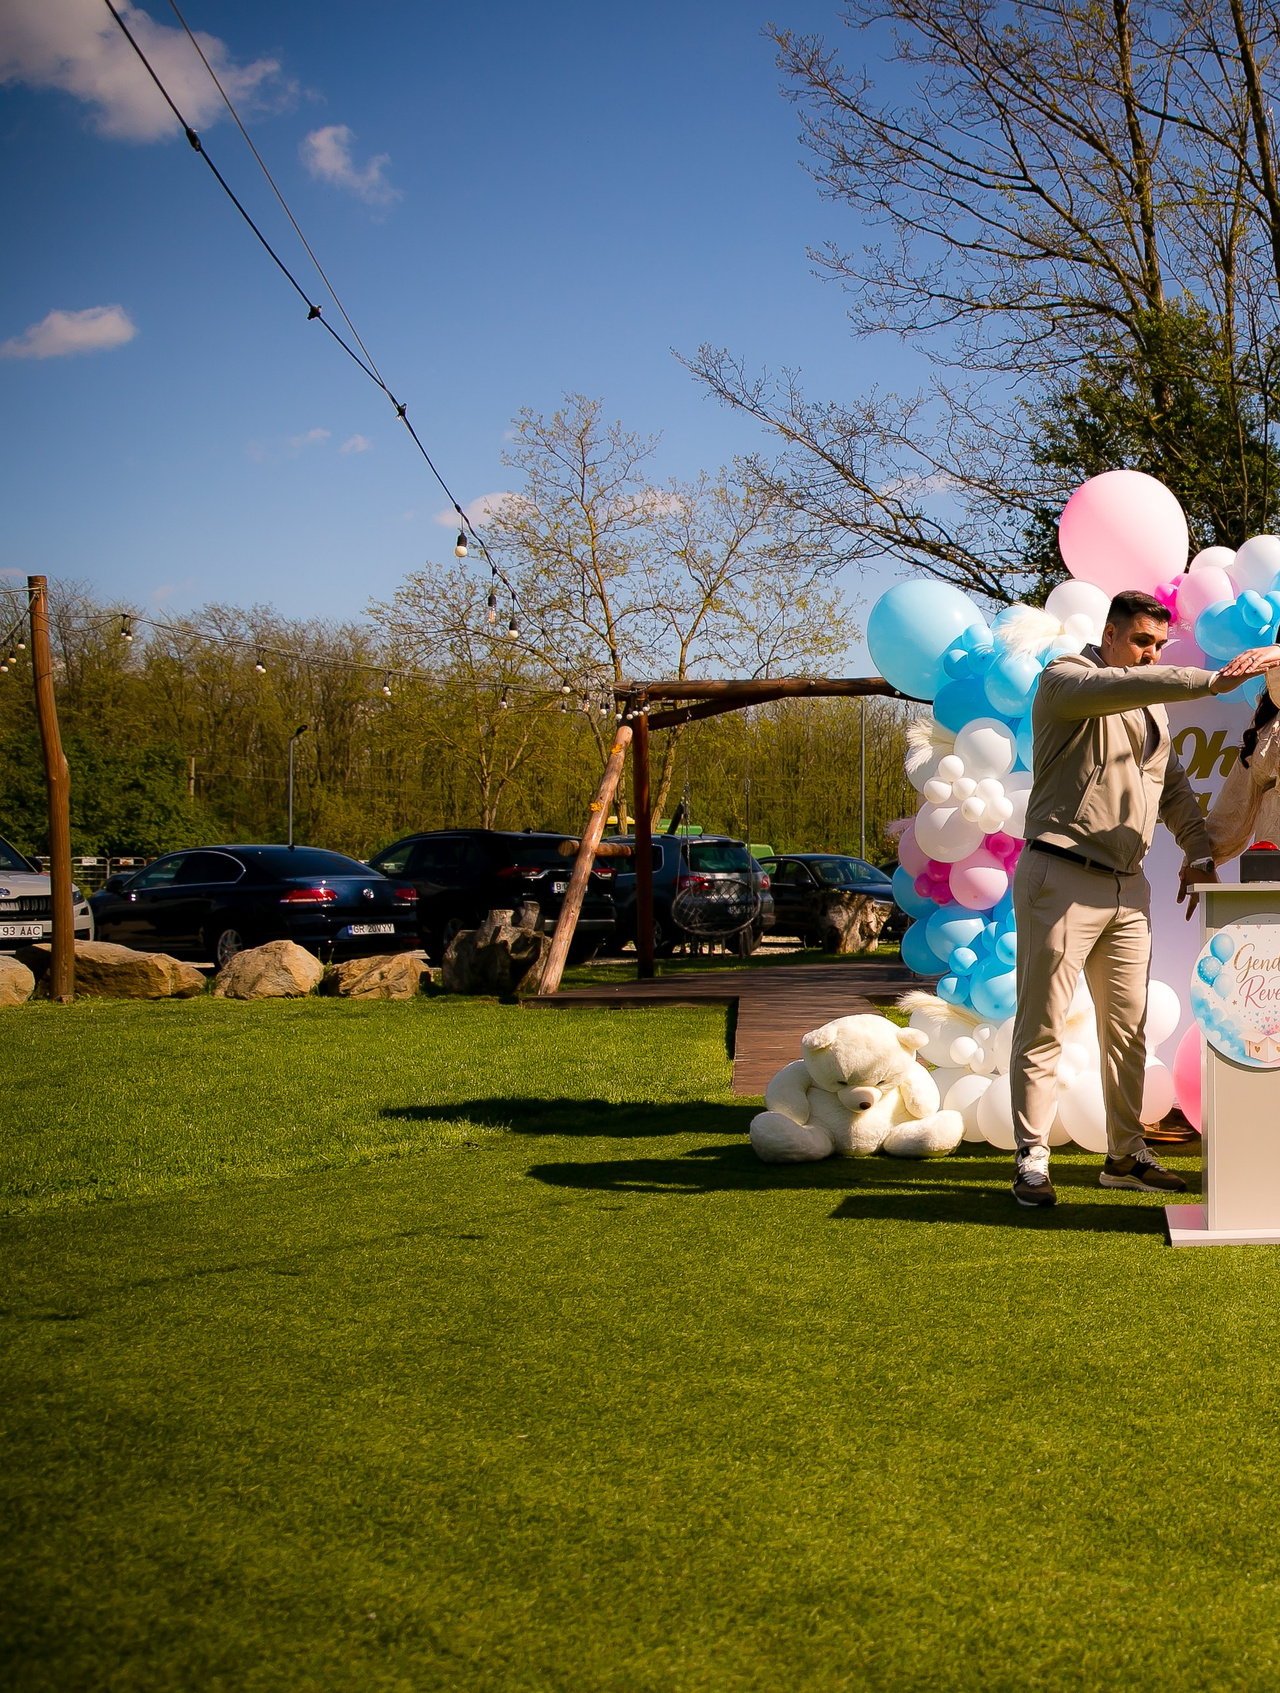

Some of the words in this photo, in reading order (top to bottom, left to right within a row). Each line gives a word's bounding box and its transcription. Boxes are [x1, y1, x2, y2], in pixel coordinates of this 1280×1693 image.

[1172, 727, 1240, 780] Oh
[2, 926, 16, 936] 93
[20, 926, 41, 936] AAC
[353, 925, 365, 934] GR
